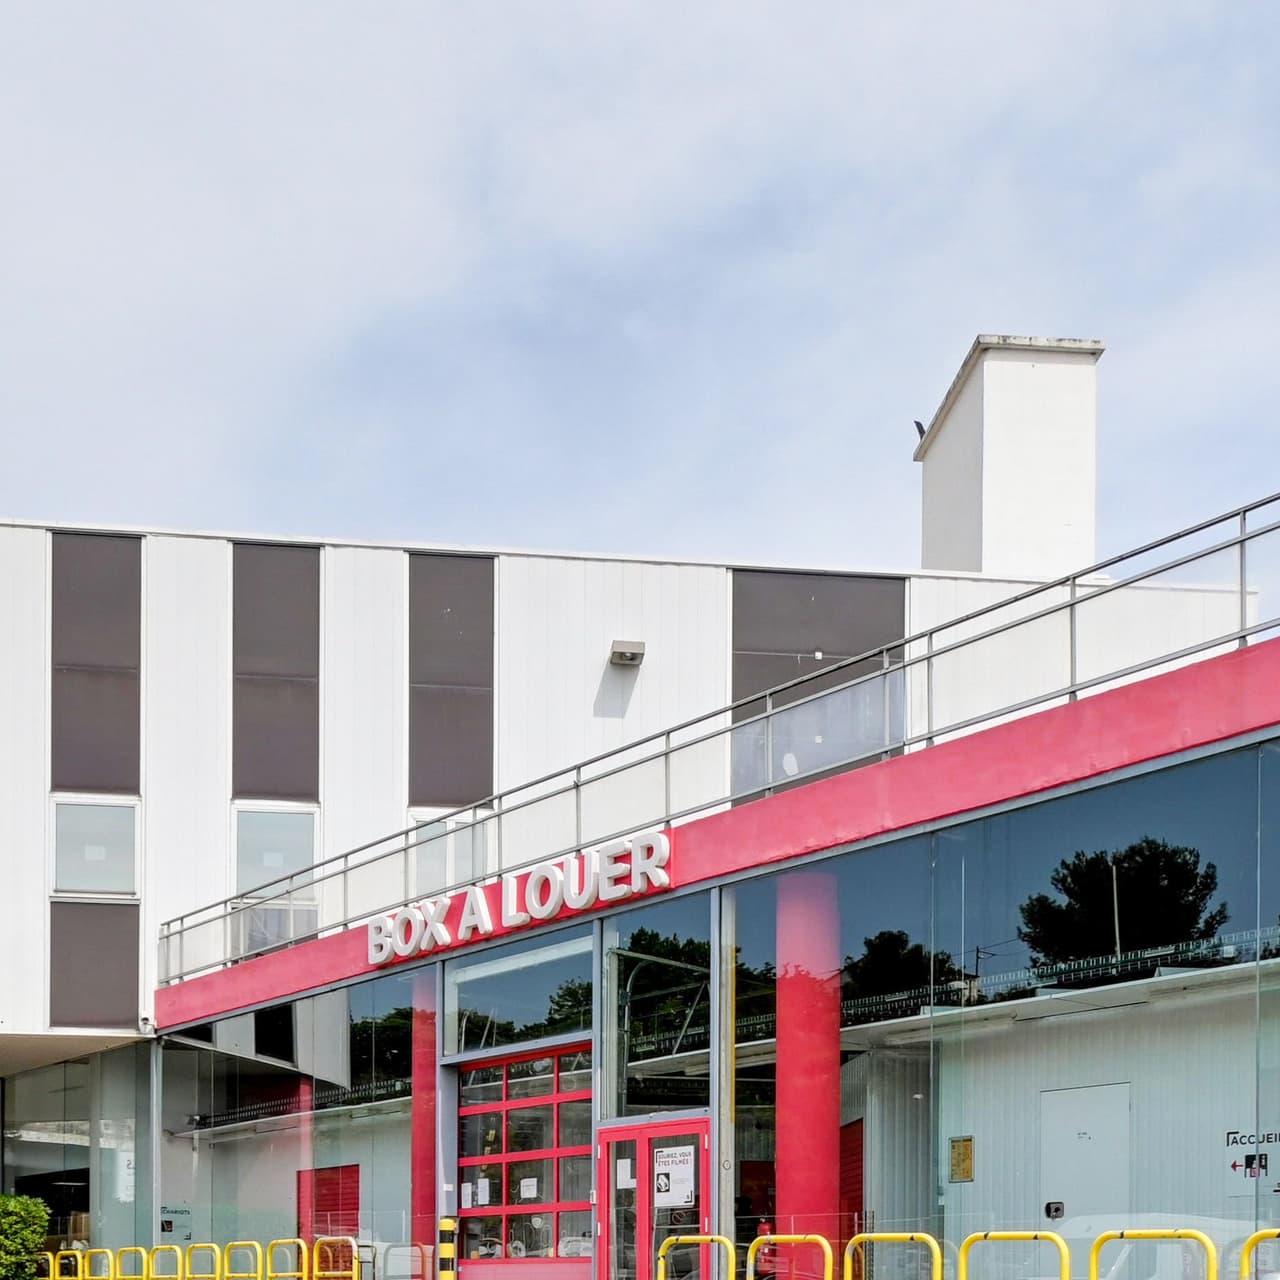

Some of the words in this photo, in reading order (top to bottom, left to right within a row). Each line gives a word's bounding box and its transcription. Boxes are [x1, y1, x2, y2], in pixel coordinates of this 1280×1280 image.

[367, 896, 451, 965] BOX
[458, 886, 493, 941] A
[502, 833, 670, 928] LOUER
